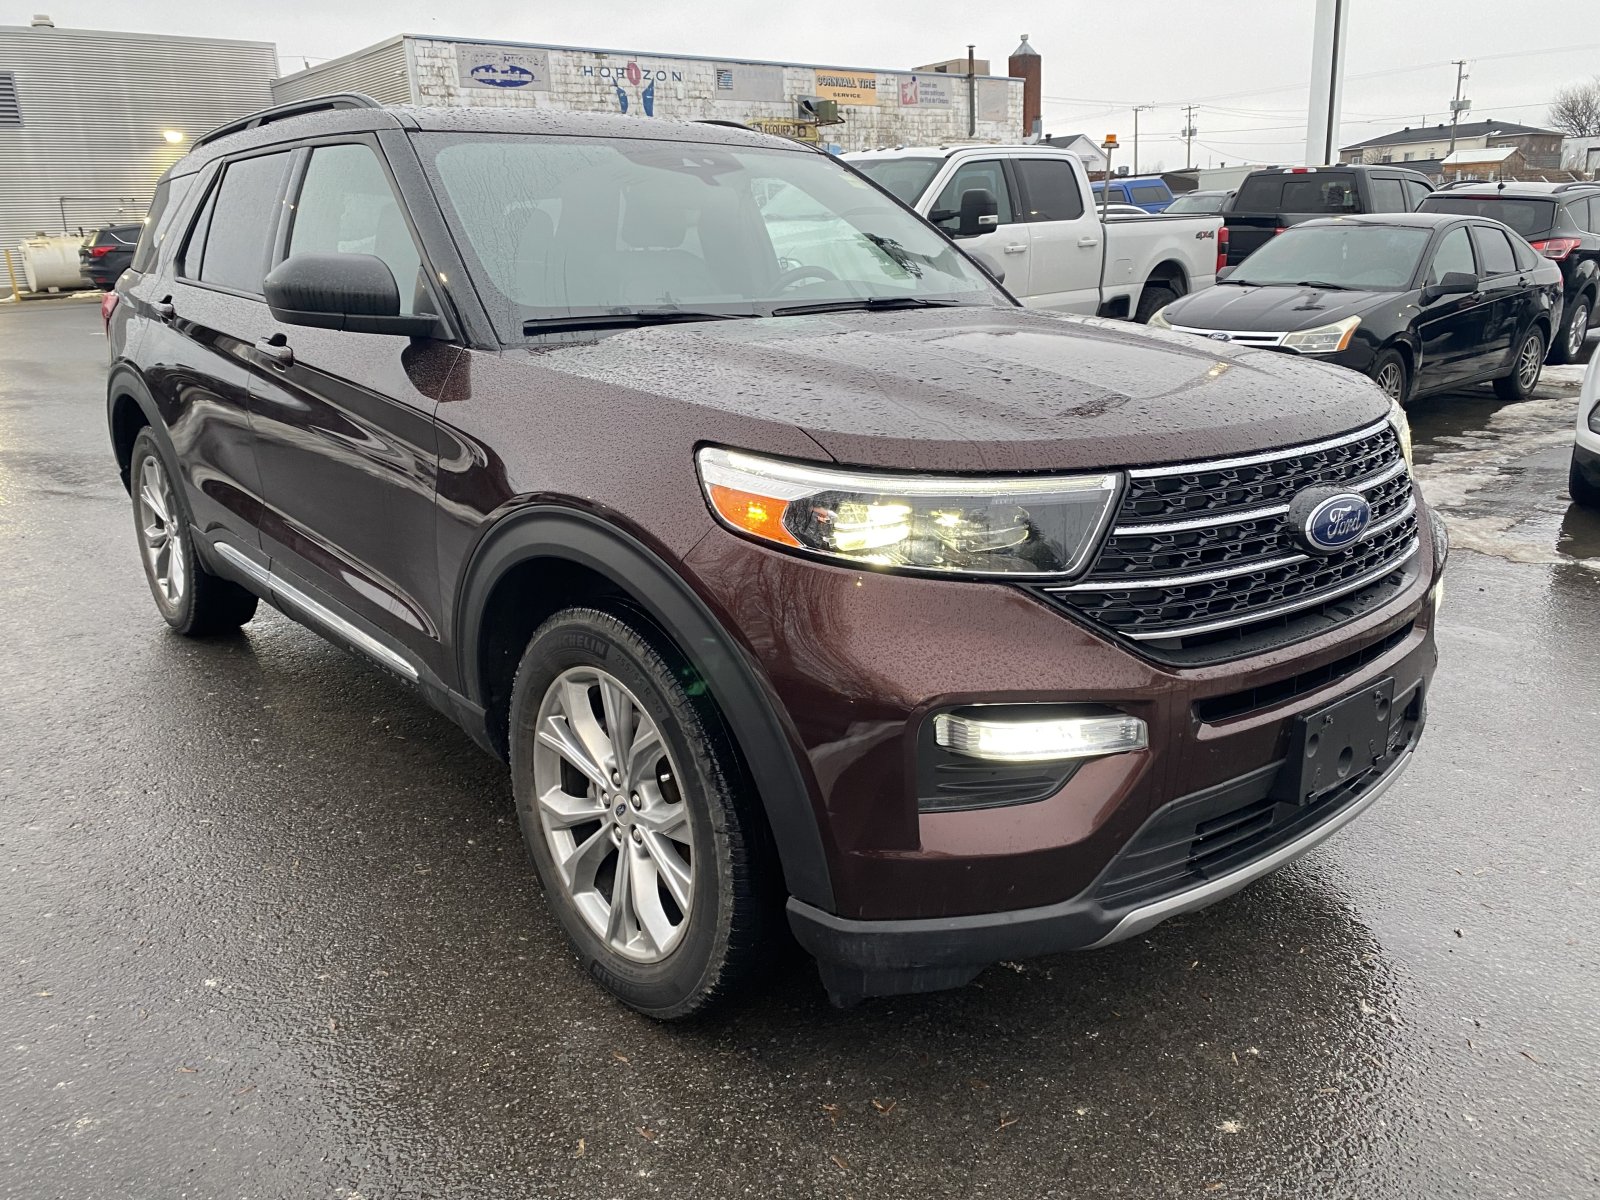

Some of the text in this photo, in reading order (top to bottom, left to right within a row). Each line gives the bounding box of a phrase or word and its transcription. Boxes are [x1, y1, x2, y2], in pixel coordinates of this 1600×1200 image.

[583, 65, 682, 81] HORIZON
[817, 75, 876, 89] CORNWALL TIRE
[1327, 505, 1362, 539] Ford
[548, 634, 606, 655] ICHELIN
